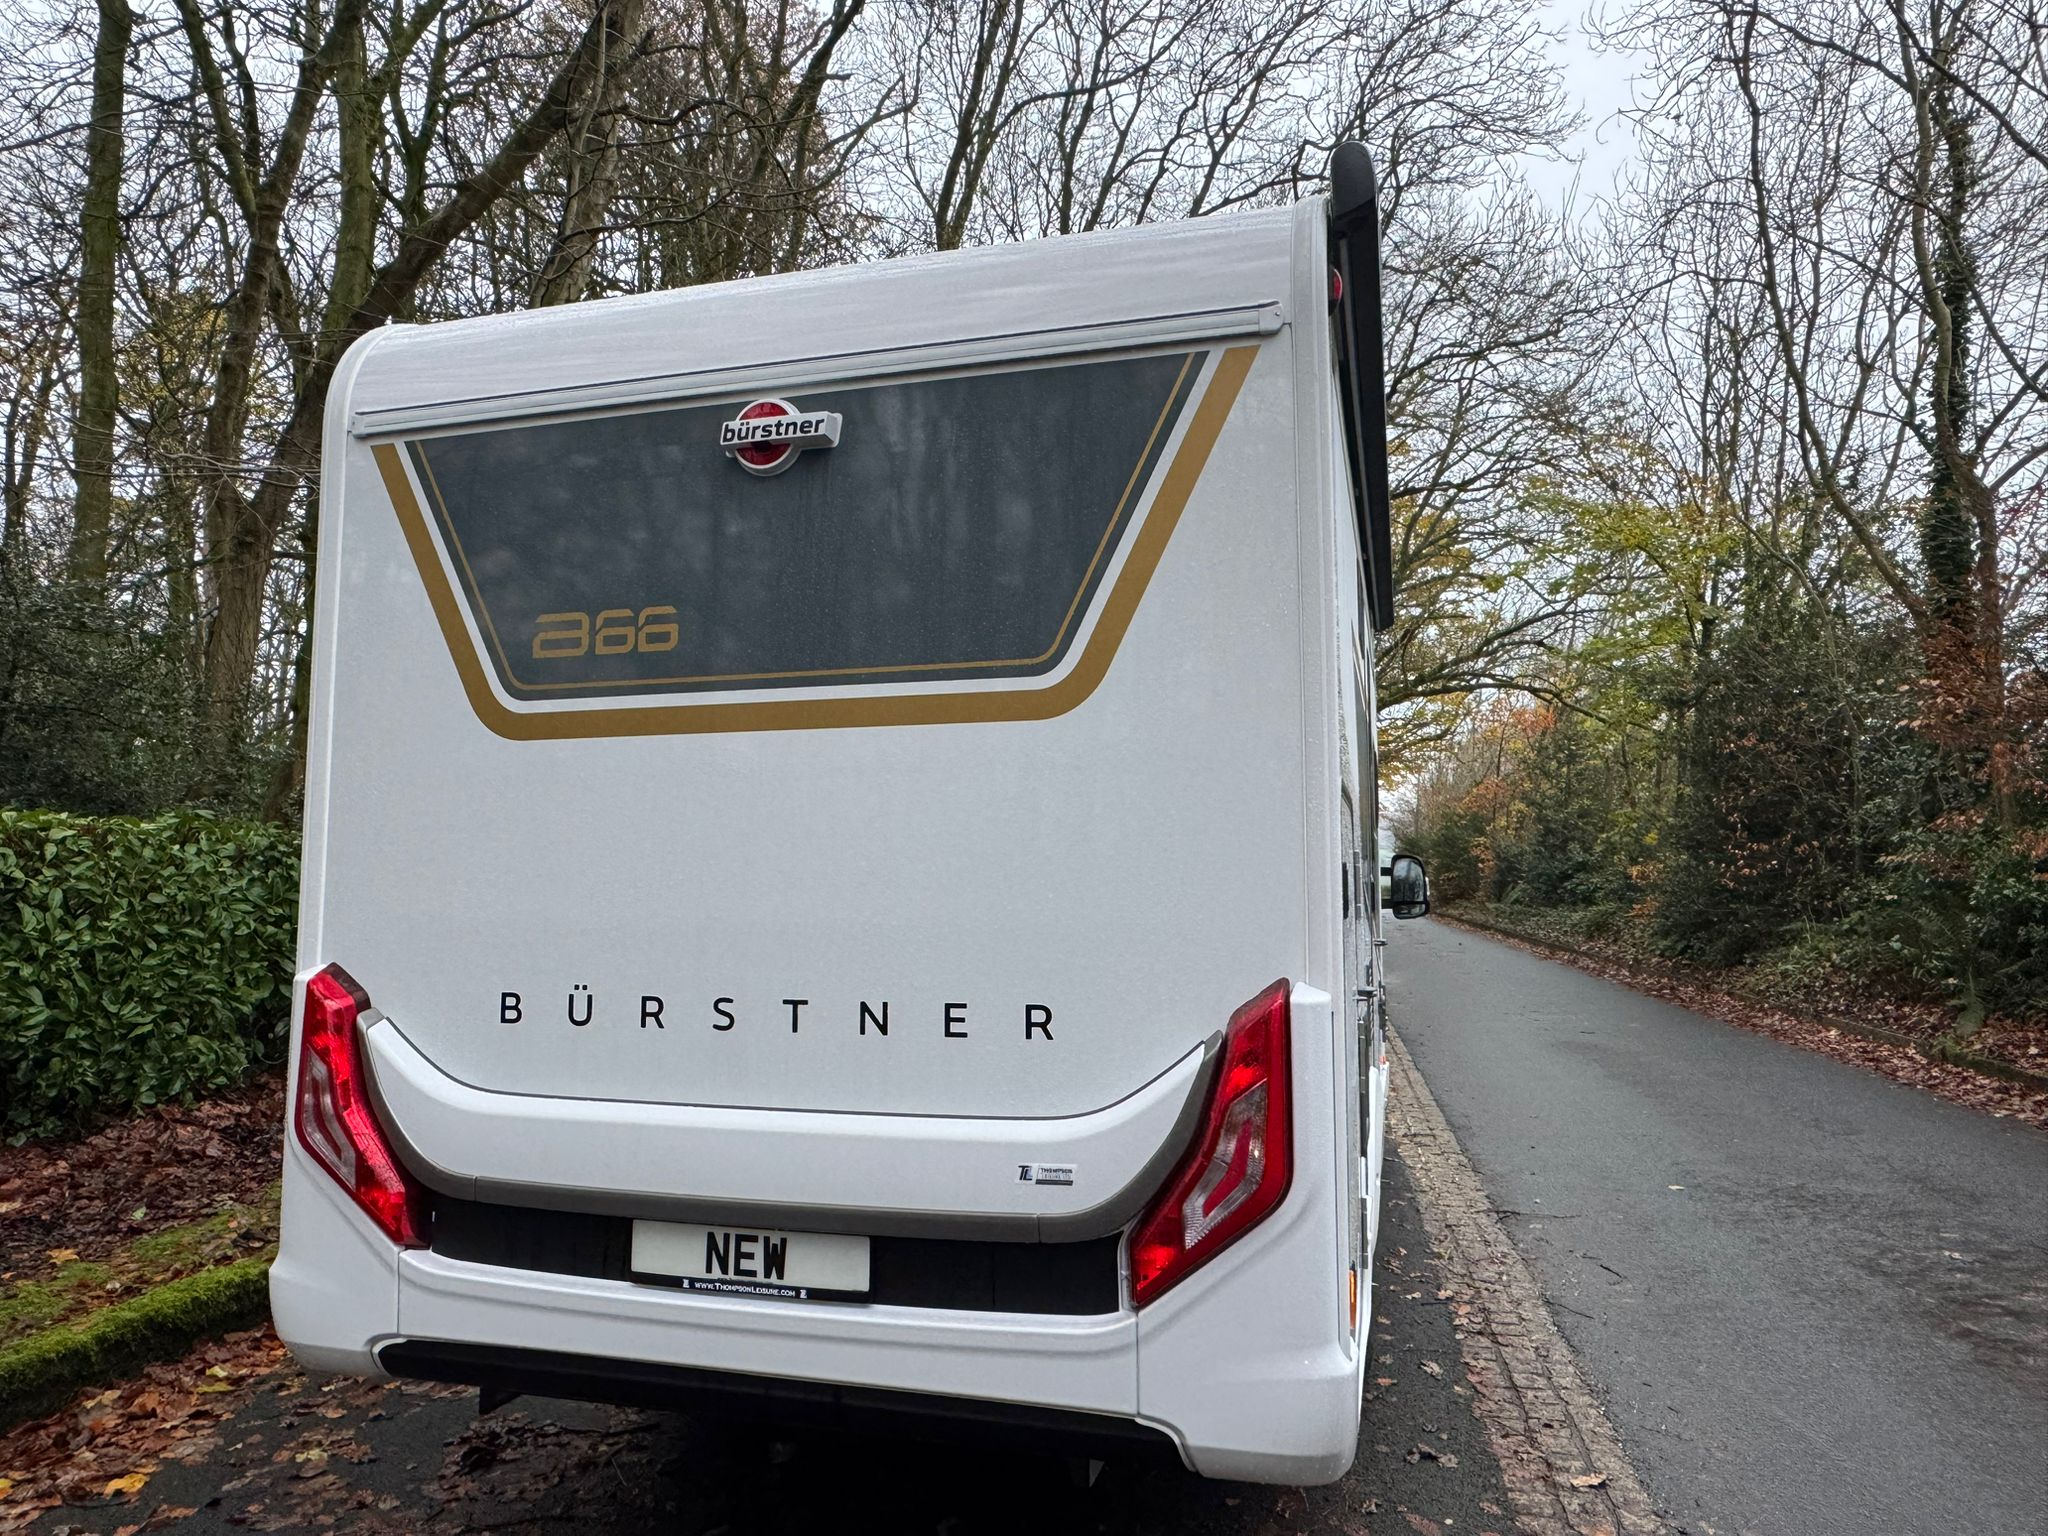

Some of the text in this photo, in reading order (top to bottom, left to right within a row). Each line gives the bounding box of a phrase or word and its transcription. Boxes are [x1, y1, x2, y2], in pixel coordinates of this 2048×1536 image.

[722, 418, 825, 443] bürstner
[500, 984, 1055, 1041] BÜRSTNER
[705, 1231, 787, 1280] NEW
